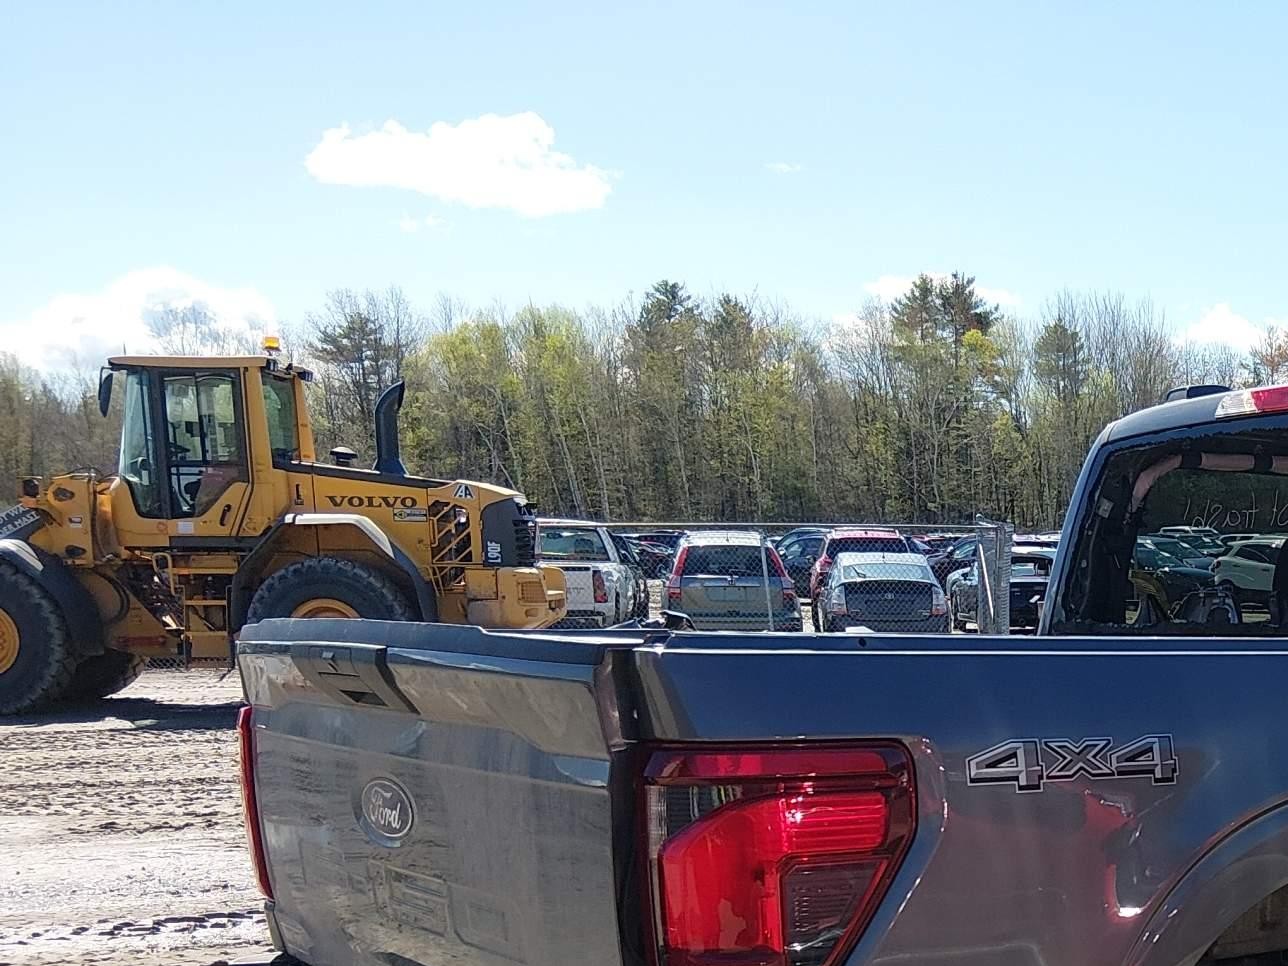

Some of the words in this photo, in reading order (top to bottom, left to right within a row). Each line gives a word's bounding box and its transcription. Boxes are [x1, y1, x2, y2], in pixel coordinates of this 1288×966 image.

[325, 495, 417, 508] VOLVO
[487, 541, 502, 563] L90F
[367, 785, 404, 832] Ford
